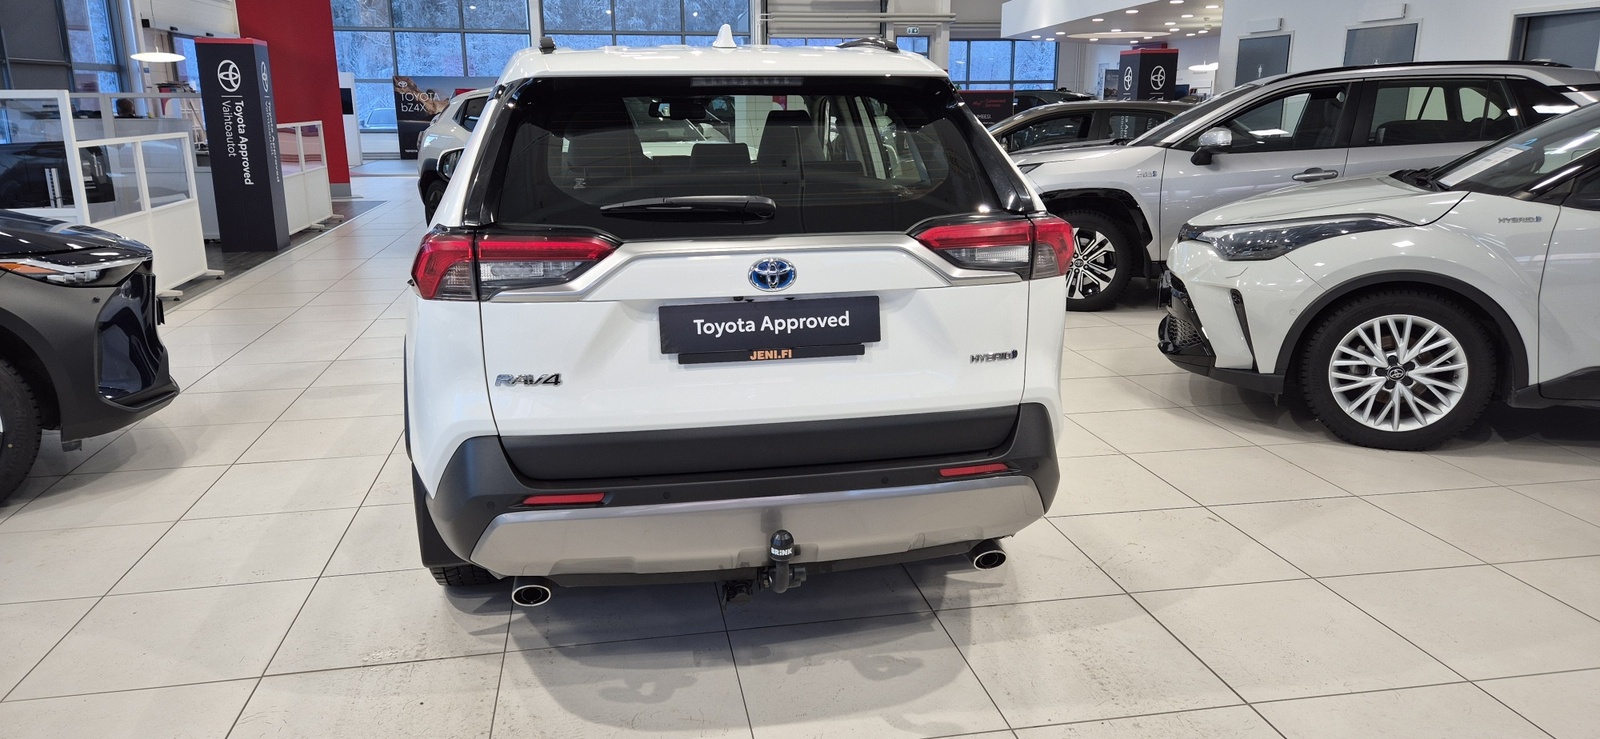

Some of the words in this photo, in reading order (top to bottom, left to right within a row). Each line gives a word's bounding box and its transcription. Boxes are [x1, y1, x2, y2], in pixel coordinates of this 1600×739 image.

[400, 92, 440, 101] TOYOTA
[401, 103, 427, 112] bZ4X
[233, 100, 247, 134] Toyota
[222, 100, 237, 157] Vaihtoautot
[237, 135, 254, 185] Approved
[1498, 216, 1535, 224] HYBRID
[693, 318, 756, 338] Toyota
[760, 310, 850, 335] Approved
[749, 348, 793, 361] JENI.FI
[970, 351, 1011, 364] HYBRID
[494, 373, 563, 387] RAV4
[770, 547, 793, 556] BRINK
